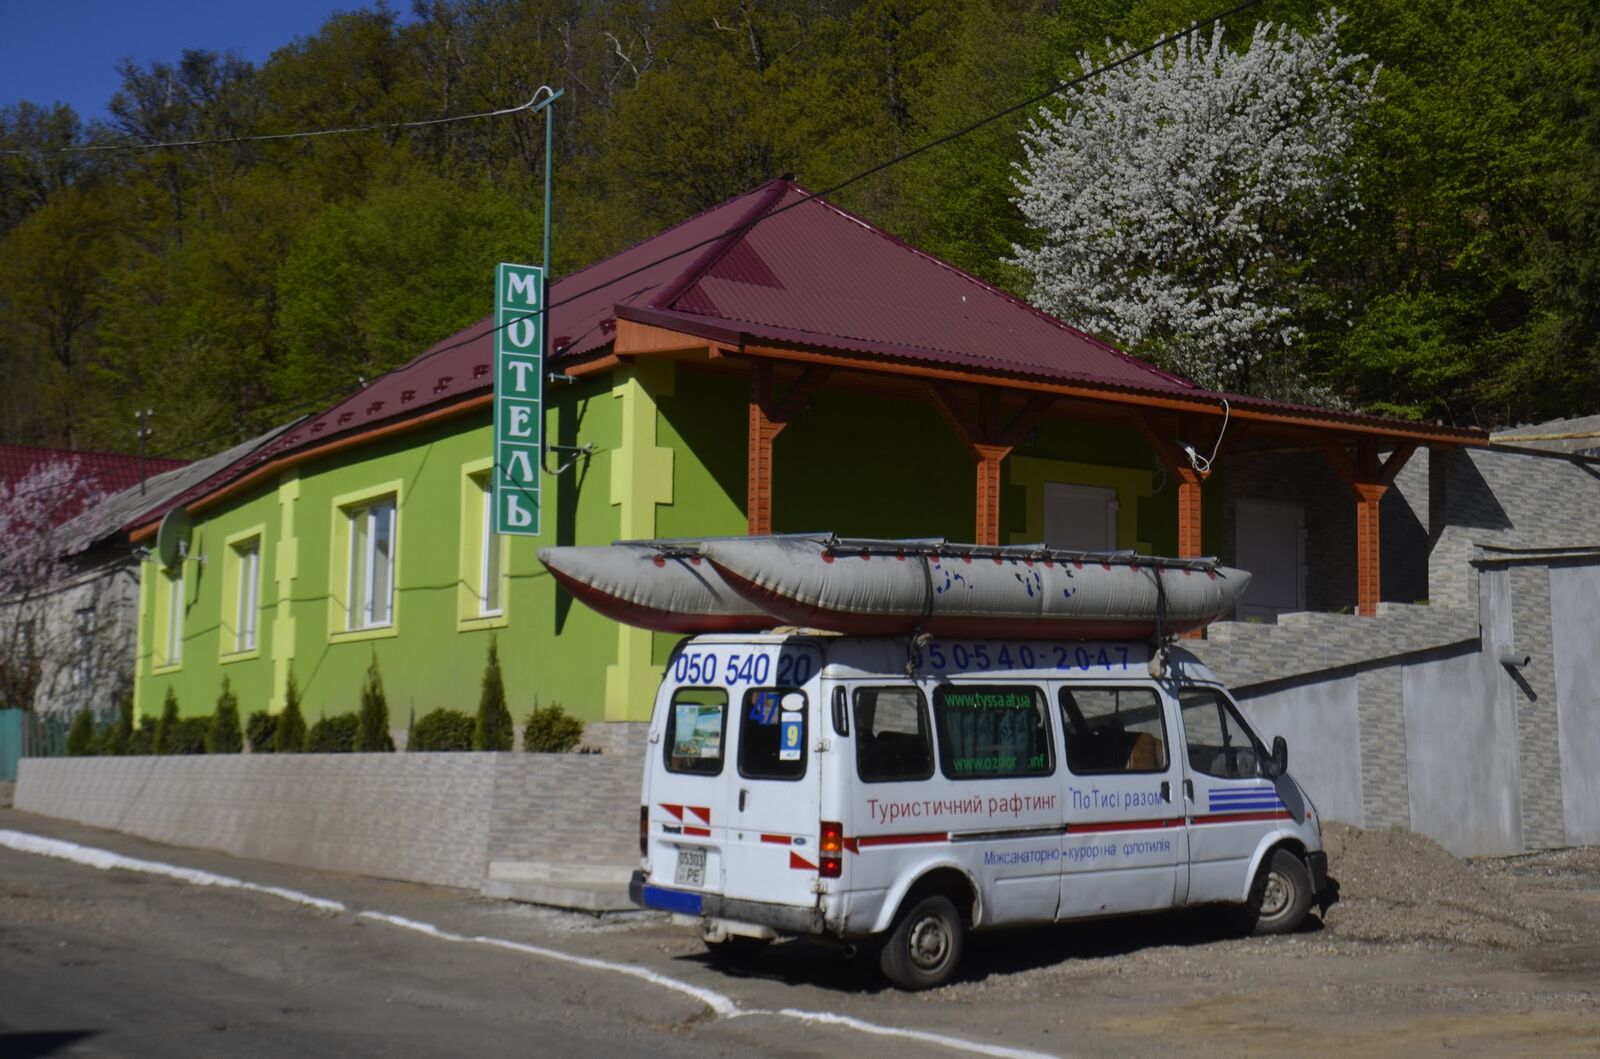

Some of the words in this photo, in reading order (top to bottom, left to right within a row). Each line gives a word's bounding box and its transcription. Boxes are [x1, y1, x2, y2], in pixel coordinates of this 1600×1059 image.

[507, 272, 536, 527] МОТЕЛЬ
[675, 653, 717, 685] 050
[725, 653, 770, 686] 540
[776, 653, 812, 687] 20
[748, 692, 780, 726] 47
[787, 725, 799, 748] 9
[867, 795, 983, 824] Туристичний
[988, 793, 1056, 818] рафтинг
[1125, 792, 1163, 811] разом
